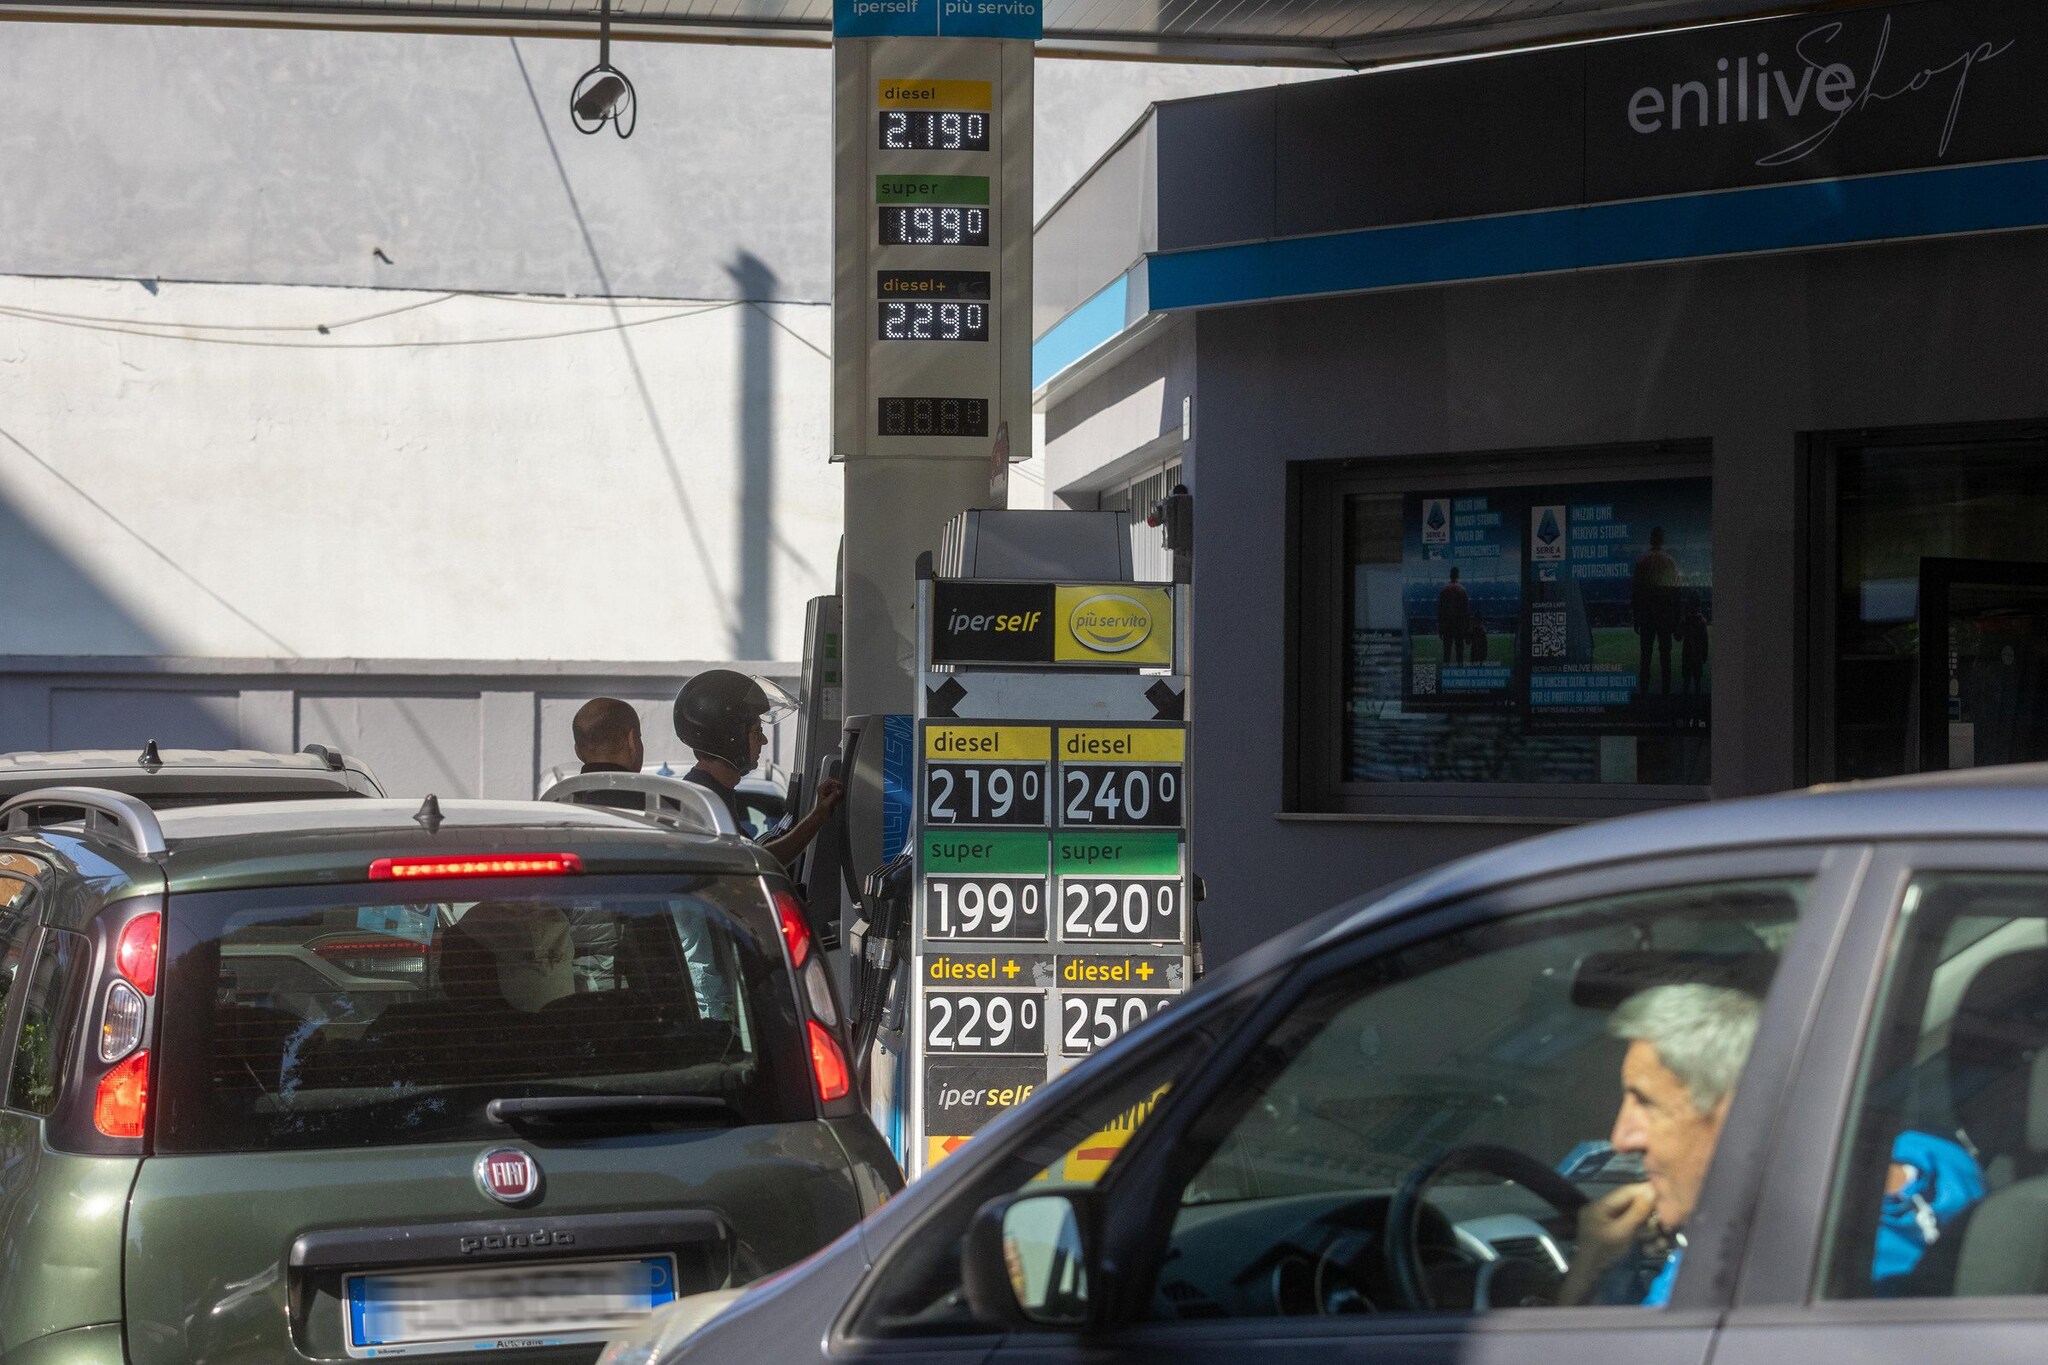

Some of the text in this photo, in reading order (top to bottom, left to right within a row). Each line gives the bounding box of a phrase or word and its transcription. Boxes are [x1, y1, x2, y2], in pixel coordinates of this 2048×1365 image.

[853, 0, 918, 16] iperself
[946, 0, 1034, 16] più servito
[885, 87, 935, 100] diesel
[1627, 13, 2015, 166] enilive Shop
[881, 182, 939, 196] super
[1595, 506, 1611, 520] UNA
[1572, 525, 1598, 539] NUOVA
[1536, 545, 1561, 554] SERIE A
[1571, 544, 1608, 558] VIVILA DA
[948, 608, 1041, 635] iperself
[1076, 612, 1147, 629] più servito
[1563, 664, 1591, 672] ENILIVE
[1592, 663, 1622, 672] INSIEME
[934, 732, 999, 752] diesel
[1067, 734, 1131, 754] diesel
[931, 842, 993, 862] super
[1061, 843, 1122, 864] super
[938, 1082, 1033, 1110] iperself
[492, 1161, 525, 1187] FIAT
[460, 1228, 575, 1254] panda
